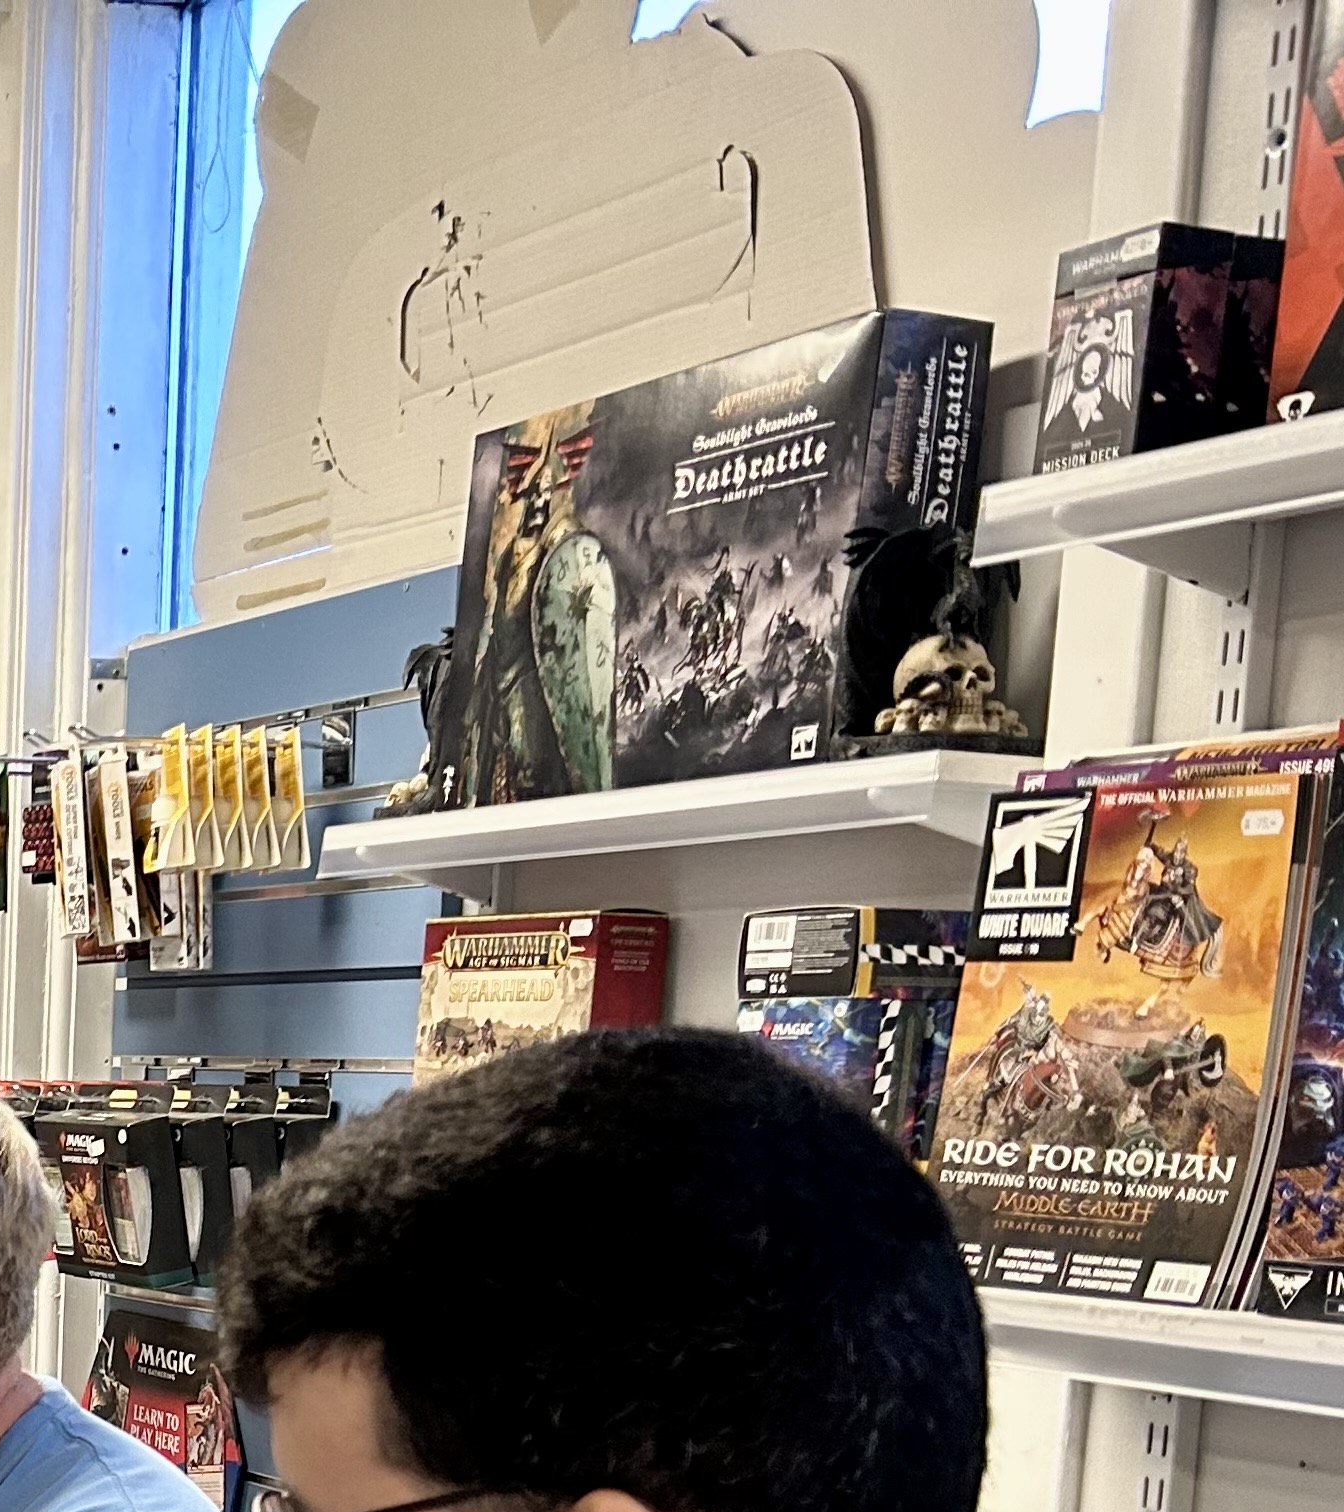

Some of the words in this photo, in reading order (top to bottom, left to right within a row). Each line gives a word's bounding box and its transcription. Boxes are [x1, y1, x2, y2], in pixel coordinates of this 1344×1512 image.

[923, 343, 968, 529] Deathrattle
[673, 434, 828, 501] Deathrattle
[1042, 454, 1087, 474] MISSION
[1090, 445, 1120, 467] DECK
[1077, 772, 1140, 788] WARHAMMER
[1279, 758, 1313, 775] ISSUE
[1100, 793, 1117, 806] THE
[1118, 792, 1156, 805] OFFICIAL
[1157, 786, 1244, 802] WARHAMMER
[1245, 783, 1292, 797] MAGAZINE
[989, 892, 1069, 904] WARHAMMER
[978, 913, 1020, 939] WHITE
[1020, 912, 1070, 938] DWARF
[446, 934, 568, 969] WARHAMMER
[998, 943, 1024, 955] ISSUE
[448, 977, 554, 1004] SPEARHEAD
[770, 1022, 815, 1036] MAGIC
[942, 1138, 1019, 1167] RIDE
[1027, 1144, 1092, 1174] FOR
[1104, 1150, 1237, 1183] ROHAN
[939, 1169, 1025, 1188] EVERYTHING
[1026, 1174, 1057, 1190] YOU
[1059, 1177, 1099, 1195] NEED
[1101, 1180, 1121, 1196] TO
[1123, 1180, 1173, 1200] KNOW
[1175, 1185, 1230, 1205] ABOUT
[993, 1219, 1054, 1233] STRATEGY
[1057, 1224, 1104, 1238] BATTLE
[1106, 1228, 1143, 1242] GAME
[137, 1343, 197, 1376] MAGIC
[132, 1403, 165, 1429] LEARN
[166, 1409, 180, 1432] TO
[153, 1430, 180, 1455] HERE
